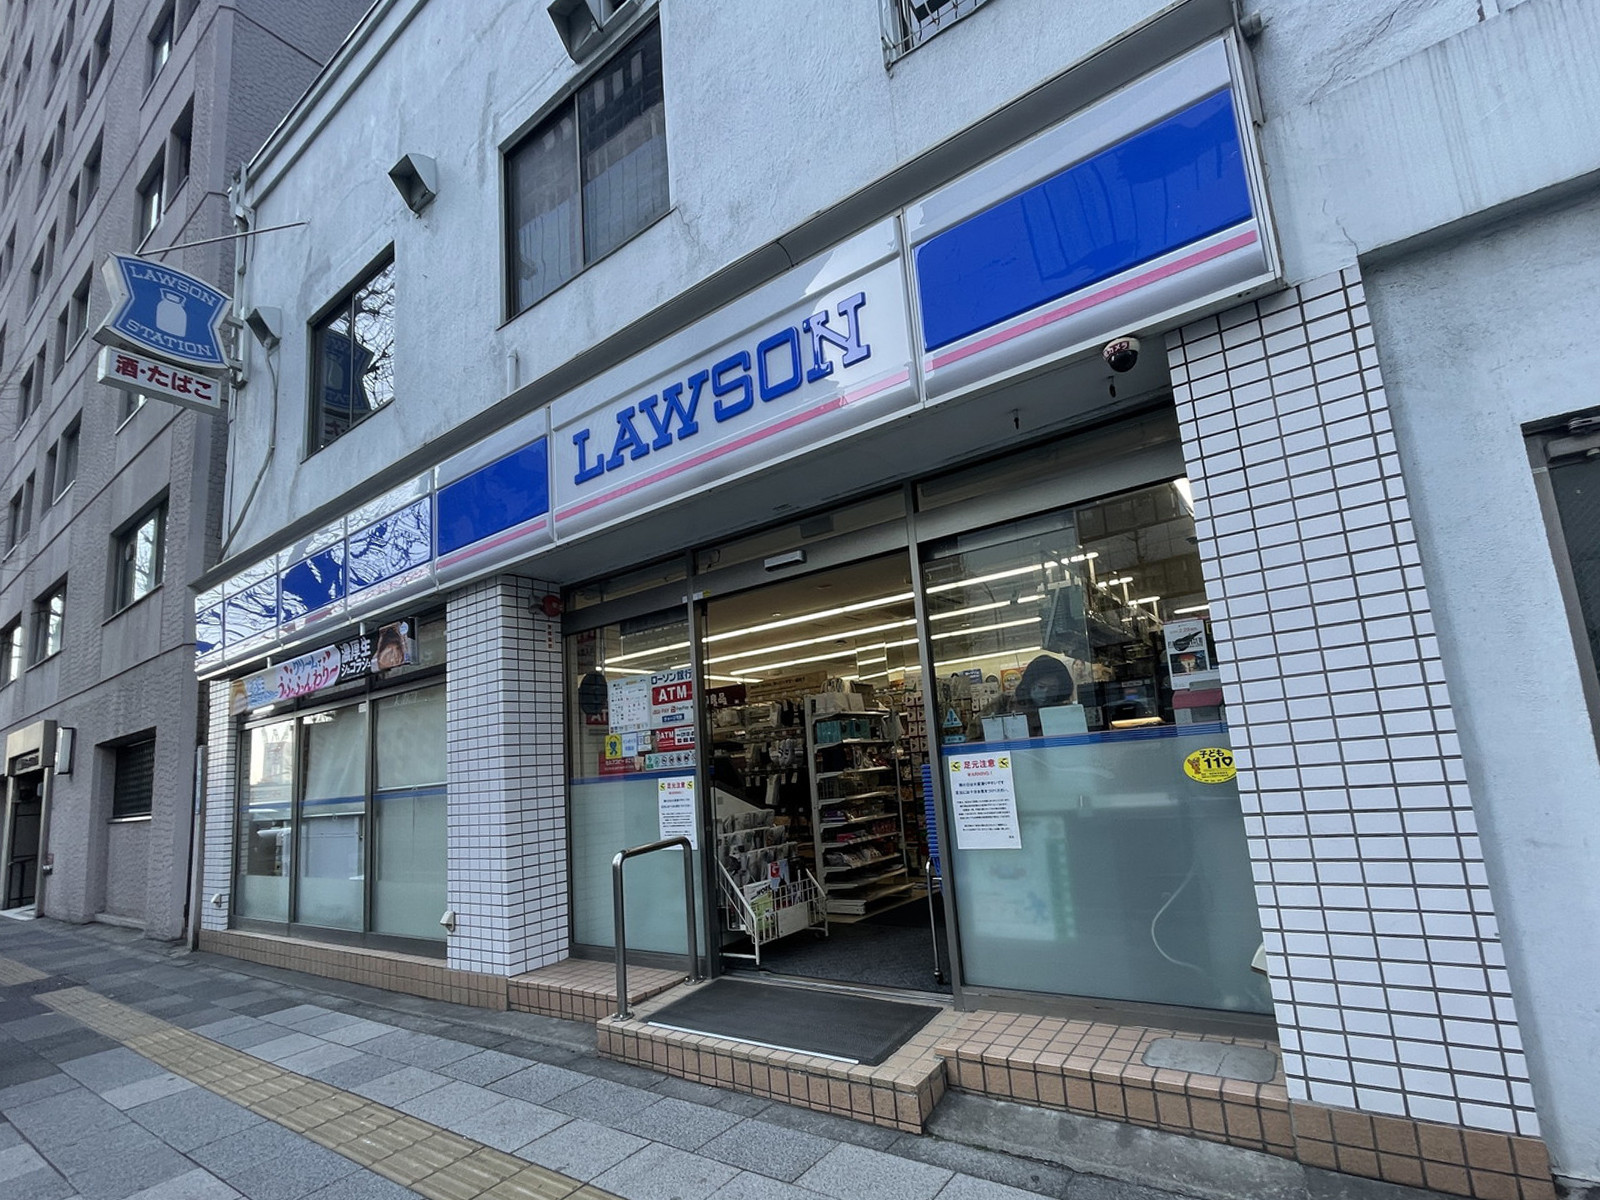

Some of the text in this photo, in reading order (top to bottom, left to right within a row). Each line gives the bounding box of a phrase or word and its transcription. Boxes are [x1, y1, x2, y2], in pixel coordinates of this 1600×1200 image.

[129, 265, 217, 307] LAWSON
[126, 319, 213, 357] STATION
[115, 354, 212, 401] 酒・たばこ
[573, 291, 871, 485] LAWSON
[651, 669, 692, 685] ローソン銀行
[659, 685, 687, 702] ATM
[660, 731, 674, 739] ATM
[1199, 749, 1224, 758] 子ども
[964, 759, 995, 769] 足元注意
